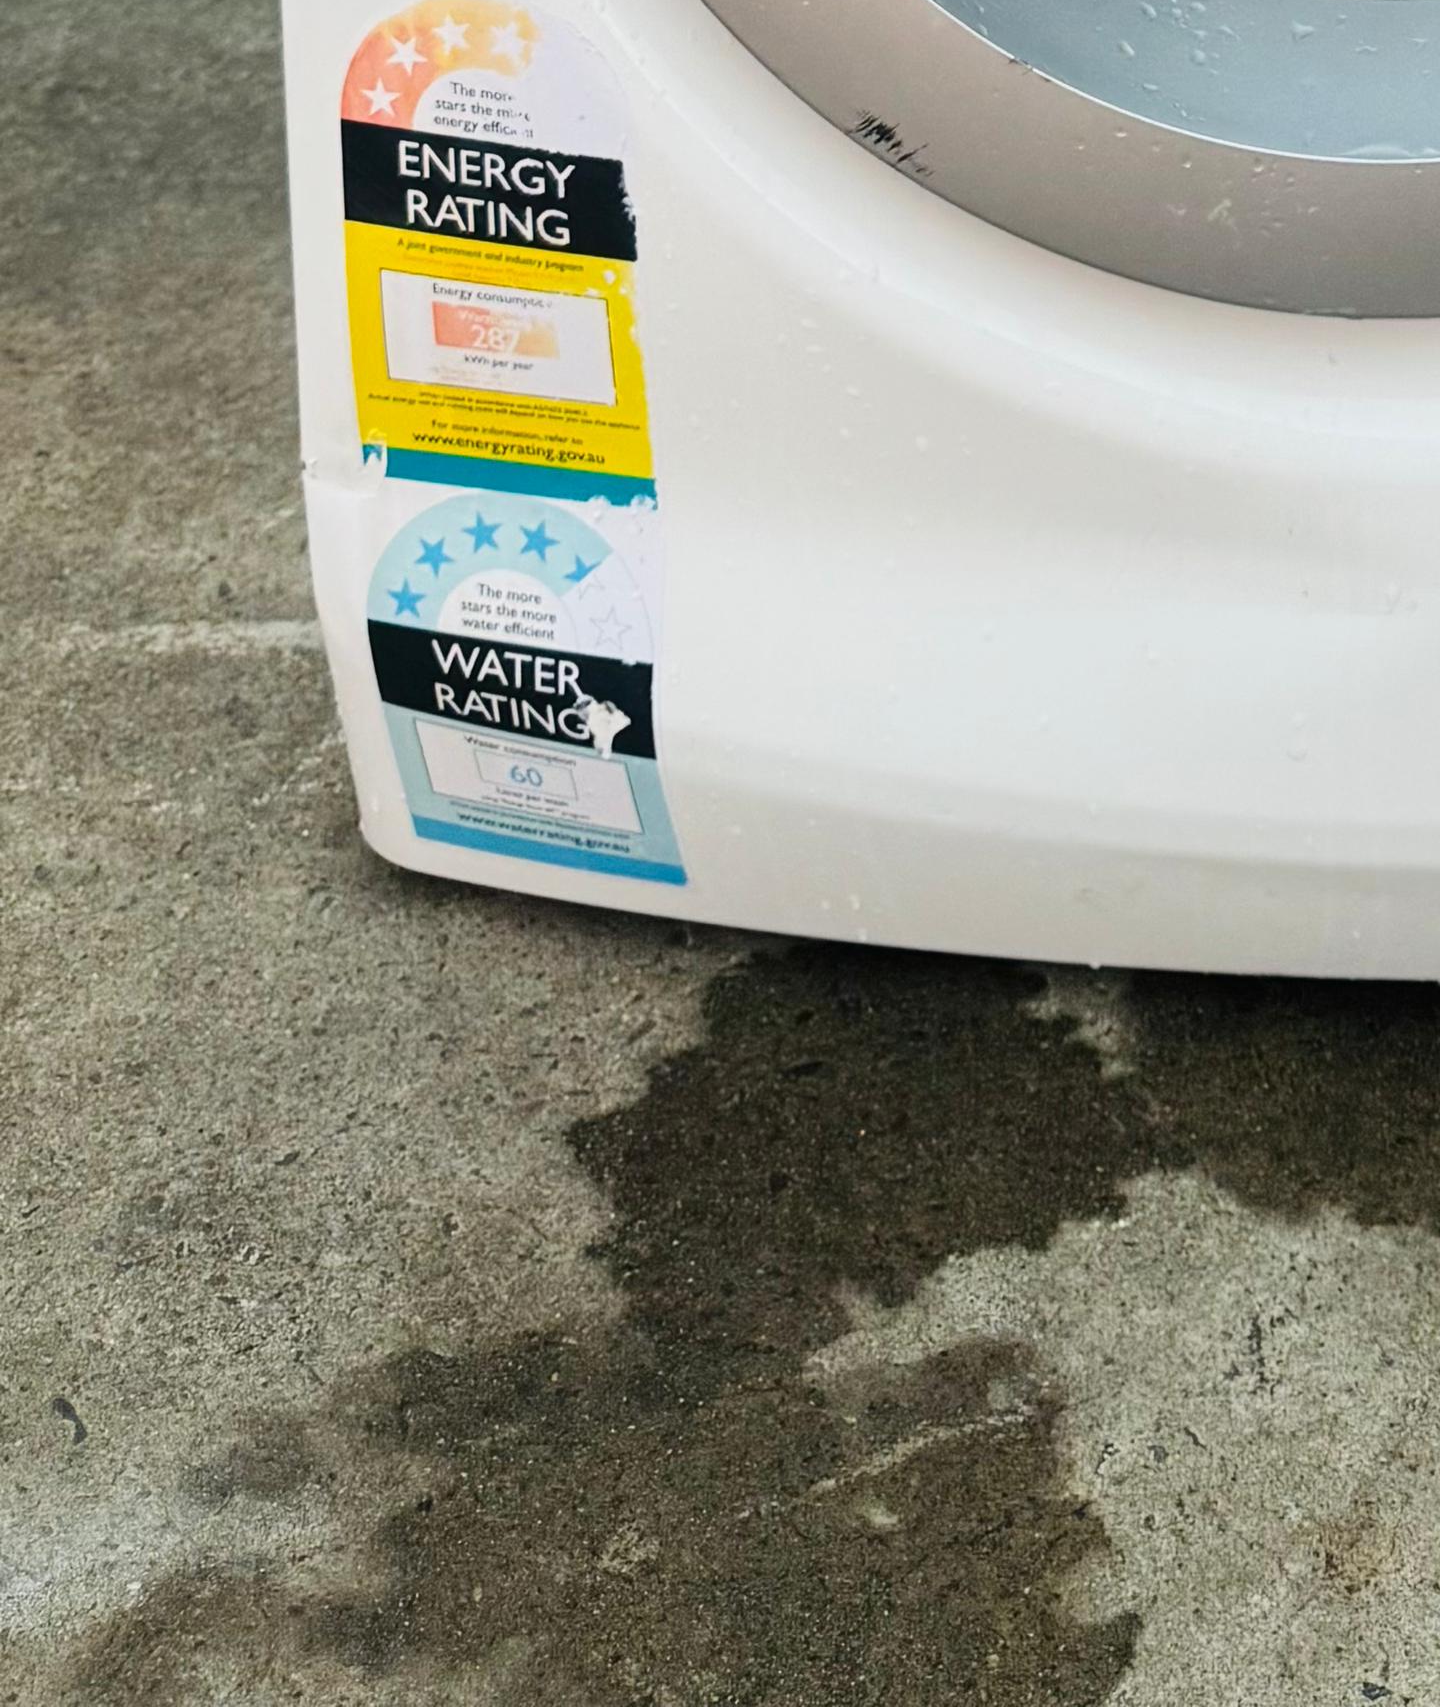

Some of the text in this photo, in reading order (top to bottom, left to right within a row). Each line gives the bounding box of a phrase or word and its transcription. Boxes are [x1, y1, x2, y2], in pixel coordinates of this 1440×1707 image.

[449, 81, 476, 98] The
[434, 99, 467, 113] stars
[471, 102, 493, 116] the
[434, 116, 478, 134] energy
[397, 140, 575, 199] ENERGY
[405, 189, 571, 247] RATING
[432, 283, 472, 301] Energy
[471, 324, 520, 355] 287
[412, 432, 606, 465] www.energyrating.gov.au
[478, 583, 542, 606] The more
[461, 601, 557, 625] stars the more
[462, 618, 555, 641] water efficient
[431, 638, 585, 700] WATER
[433, 681, 591, 743] RATING
[509, 764, 543, 788] 60
